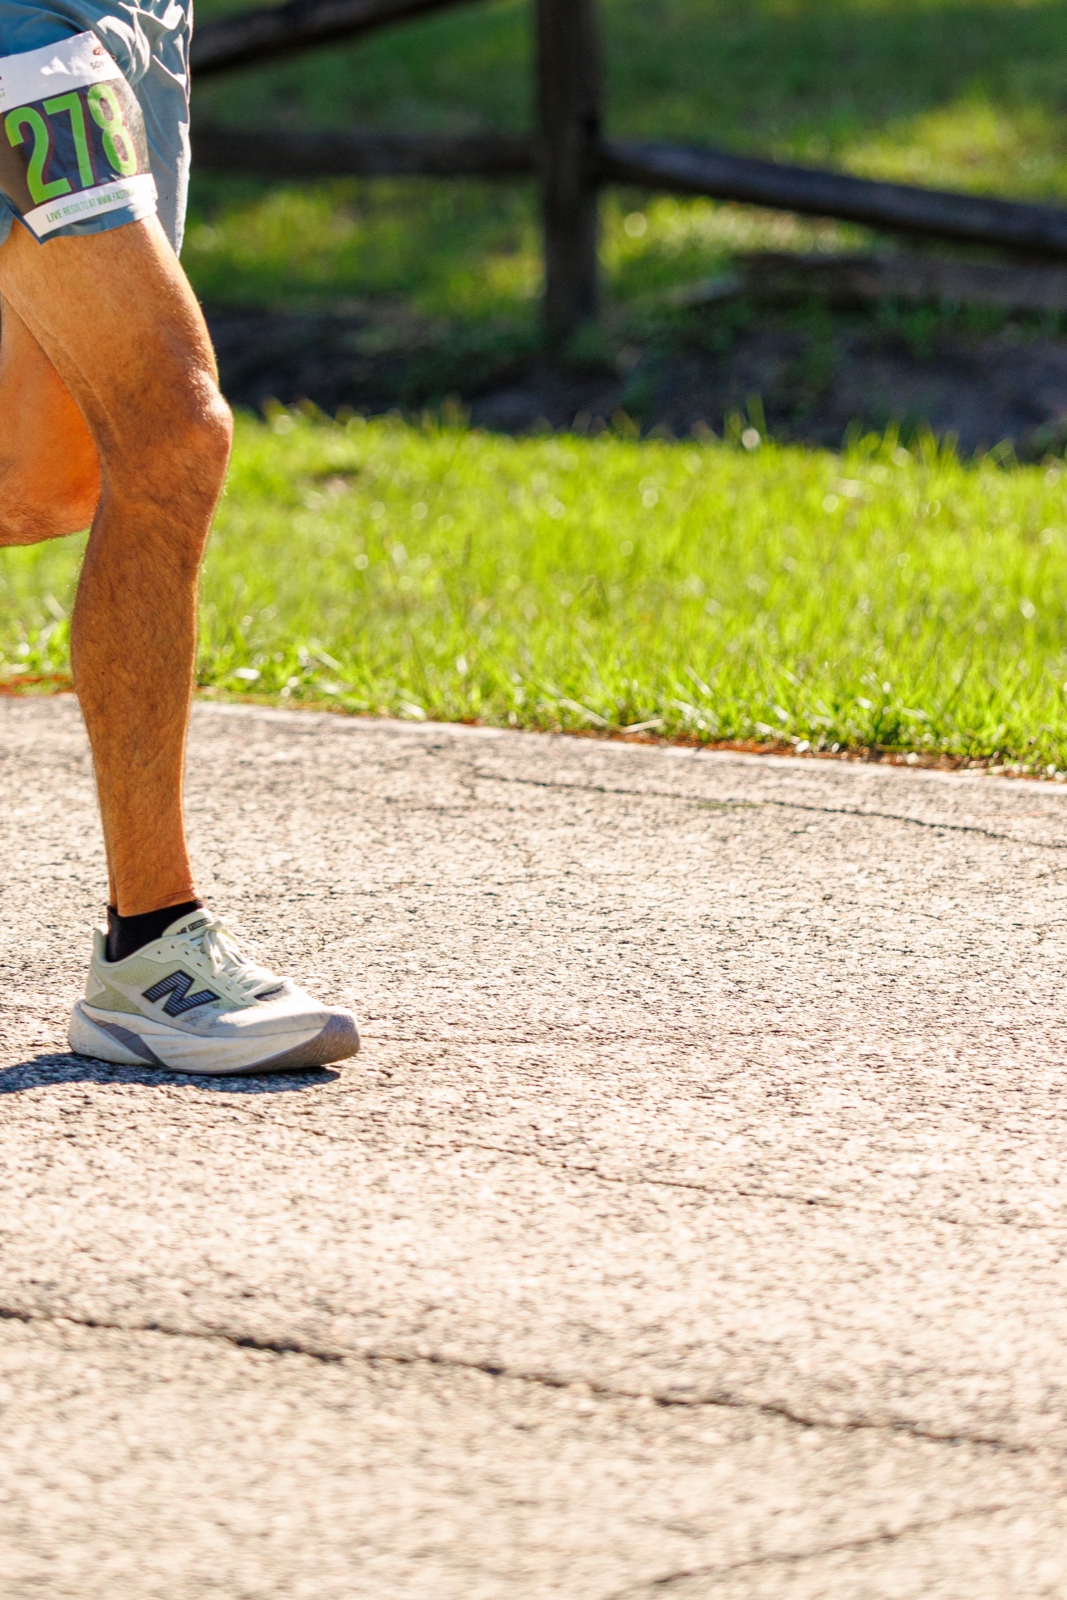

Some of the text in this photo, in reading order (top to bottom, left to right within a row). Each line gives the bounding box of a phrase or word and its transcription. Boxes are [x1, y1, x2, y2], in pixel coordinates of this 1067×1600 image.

[4, 83, 137, 205] 278
[46, 210, 62, 223] LIVE
[62, 201, 87, 216] RESULTS
[88, 199, 97, 210] AT
